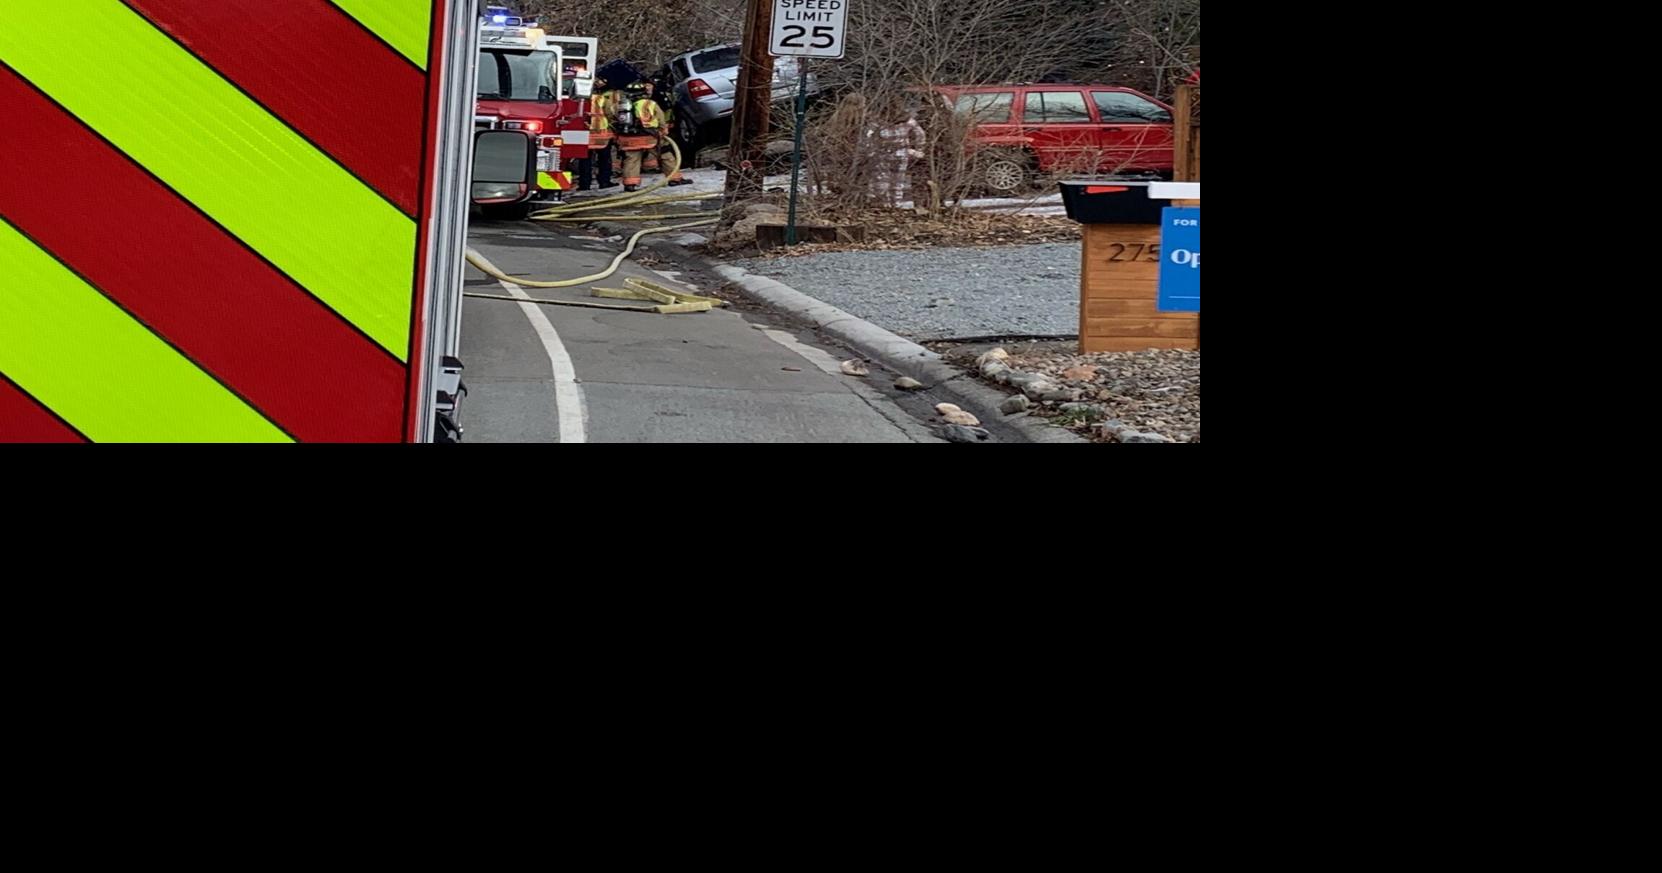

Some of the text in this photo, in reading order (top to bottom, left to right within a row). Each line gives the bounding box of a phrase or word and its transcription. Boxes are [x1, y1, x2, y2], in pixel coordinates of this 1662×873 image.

[781, 0, 841, 10] SPEED
[785, 10, 834, 22] LIMIT
[779, 24, 835, 49] 25
